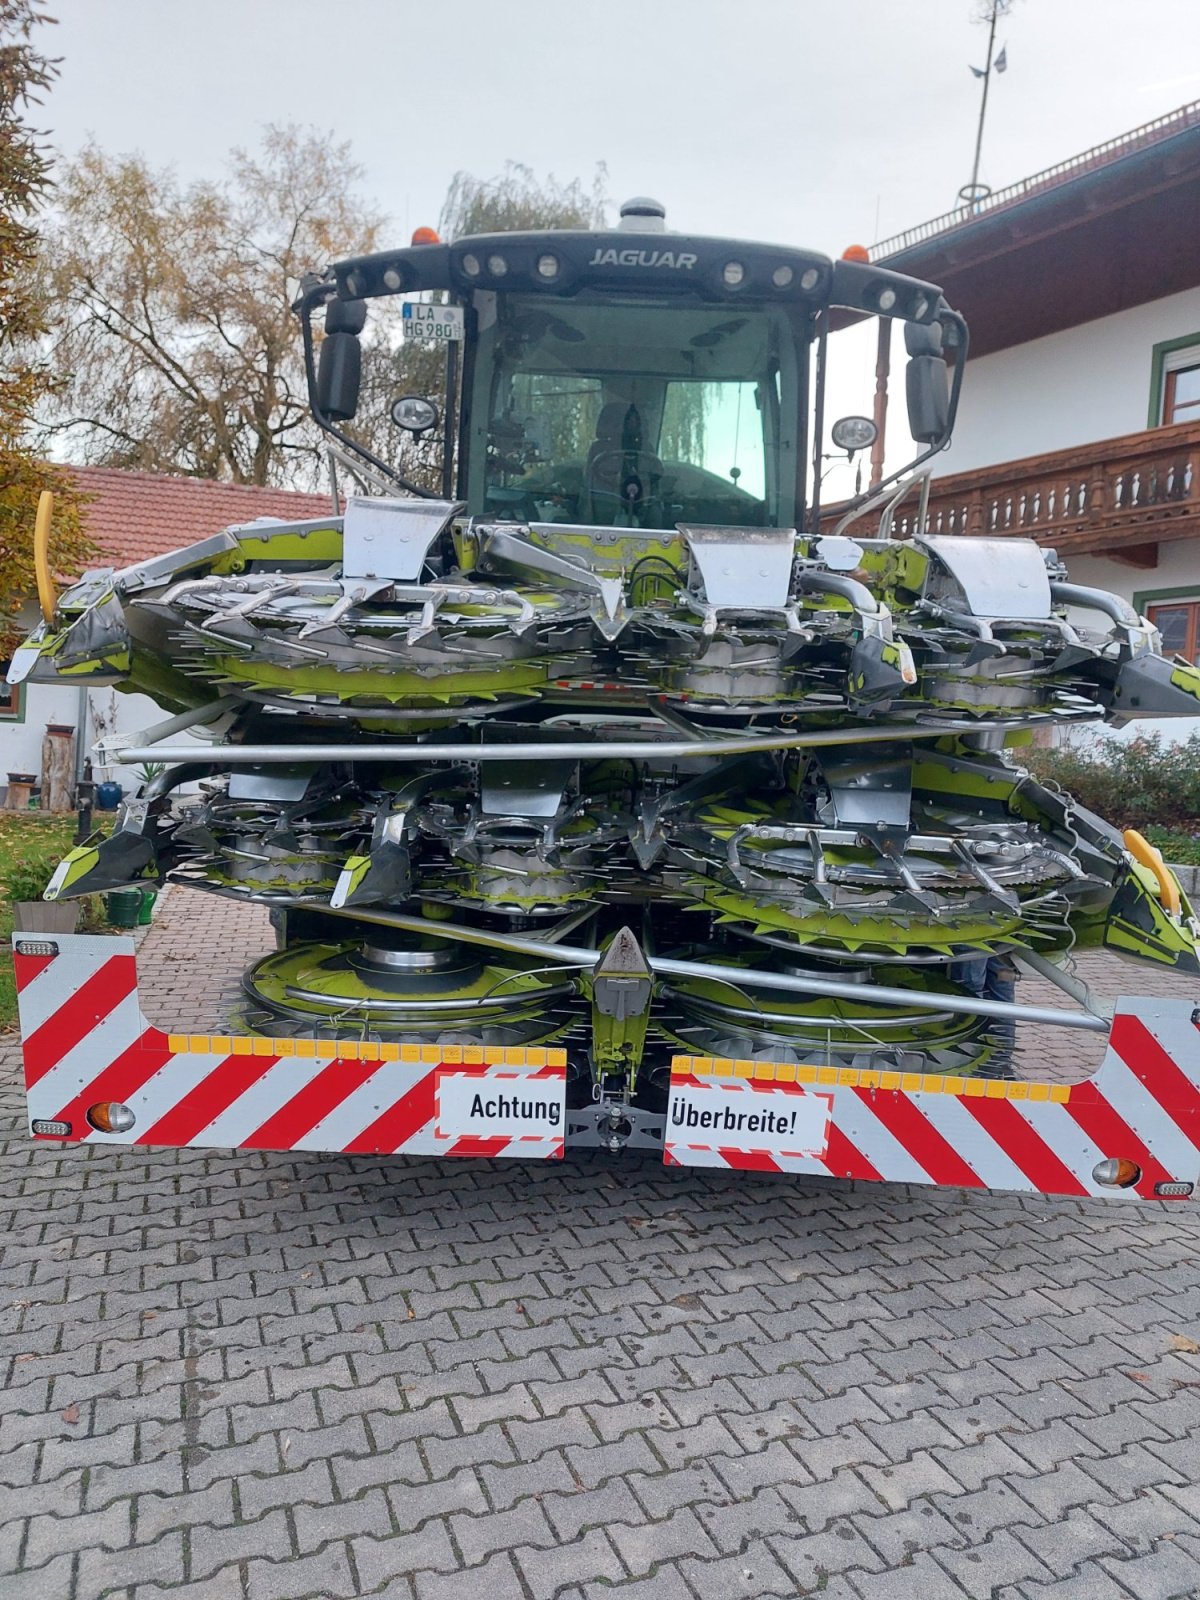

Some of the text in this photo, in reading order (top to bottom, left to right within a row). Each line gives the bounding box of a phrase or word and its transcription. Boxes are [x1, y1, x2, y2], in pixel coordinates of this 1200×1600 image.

[588, 248, 698, 270] JAGUAR
[416, 306, 435, 321] LA
[405, 321, 423, 336] HG
[426, 323, 452, 338] 980
[470, 1093, 561, 1126] Achtung
[671, 1097, 797, 1135] Überbreite!
